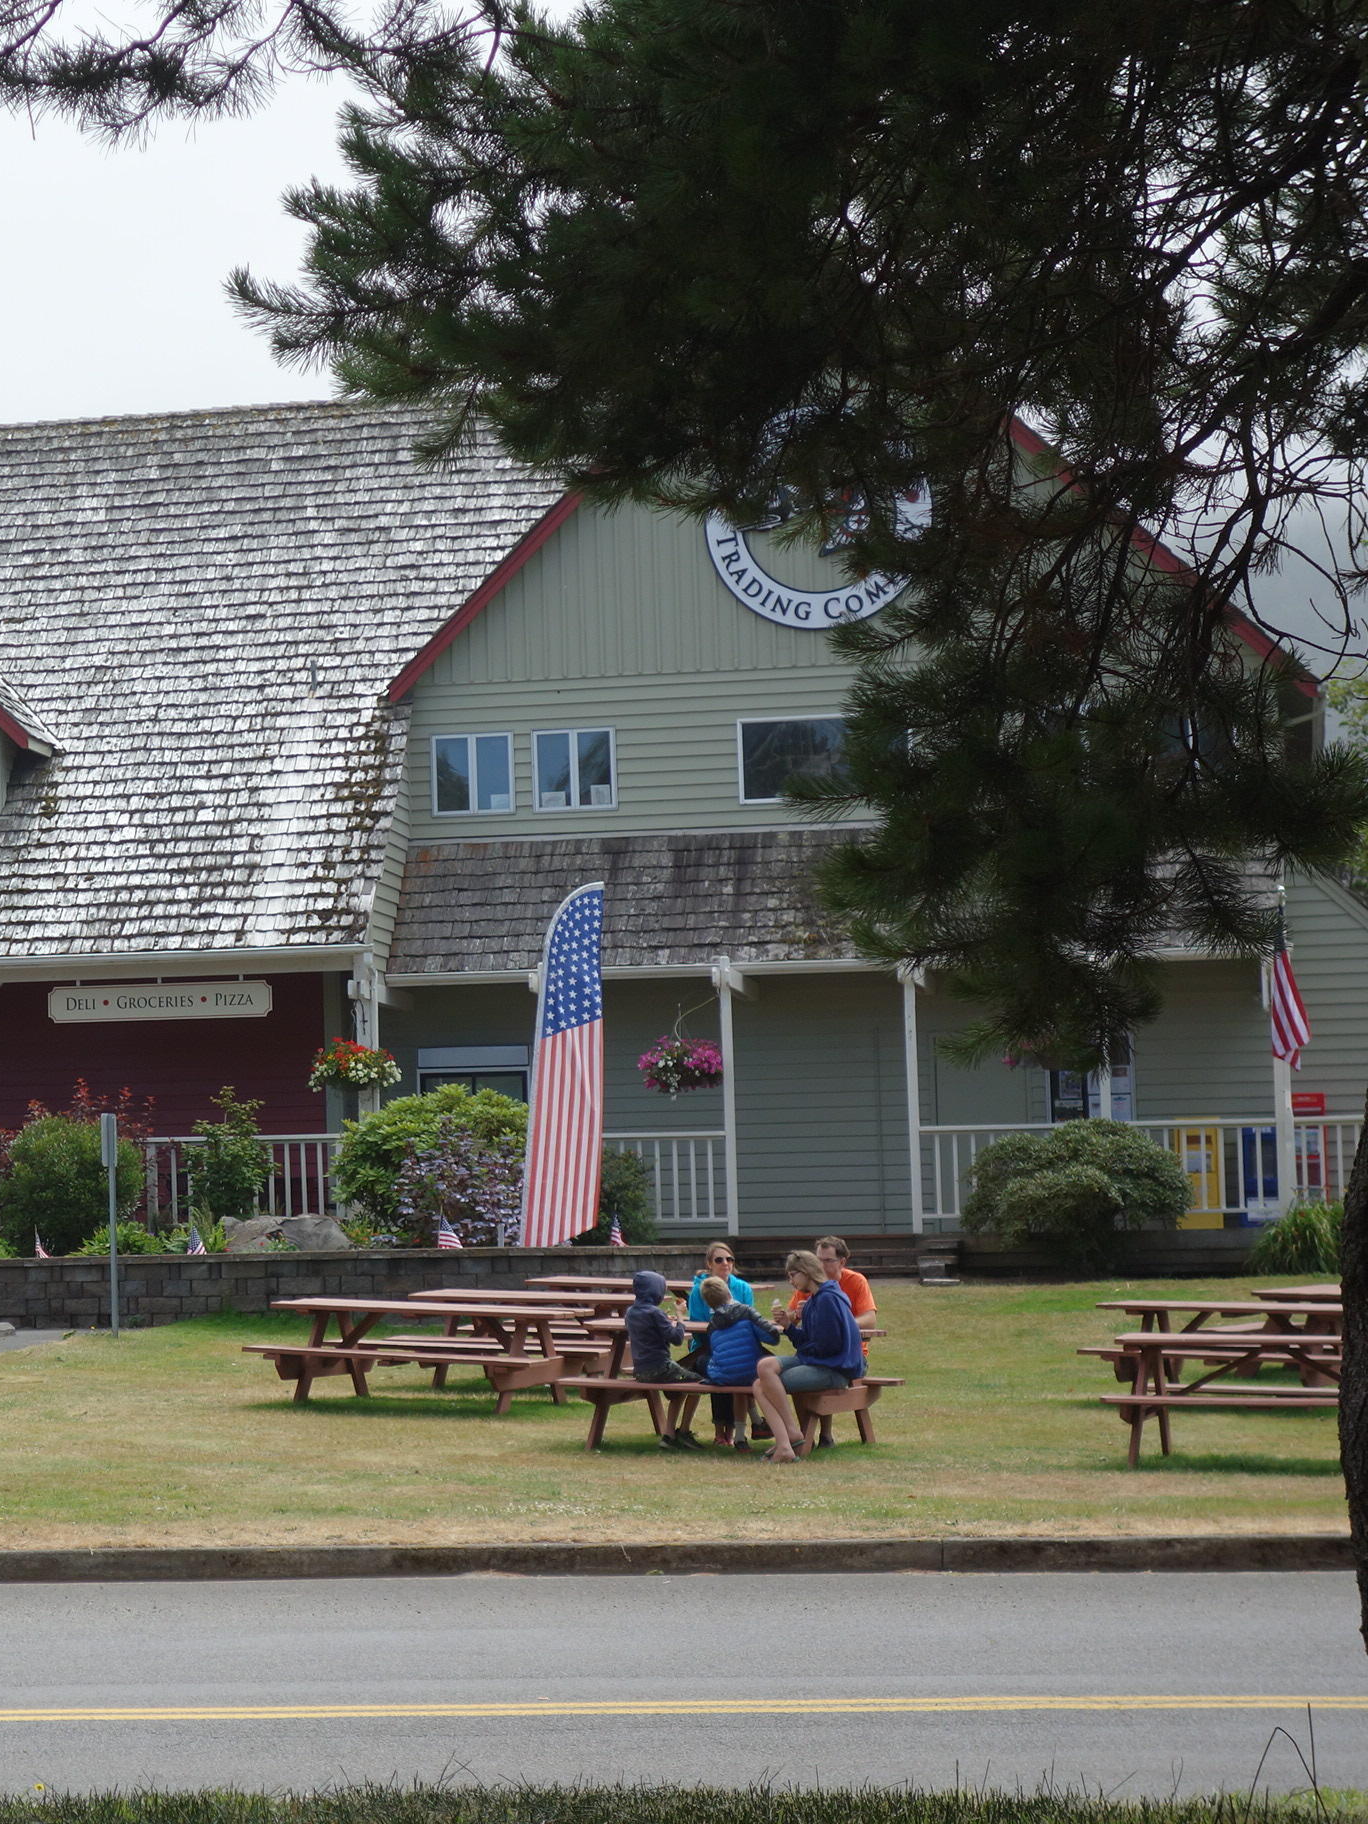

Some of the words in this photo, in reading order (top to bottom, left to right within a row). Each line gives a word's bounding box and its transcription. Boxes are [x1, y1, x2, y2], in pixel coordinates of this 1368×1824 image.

[716, 531, 812, 621] TRADING
[66, 997, 96, 1011] DELI
[116, 994, 194, 1009] GROCERIES
[215, 992, 254, 1006] PIZZA
